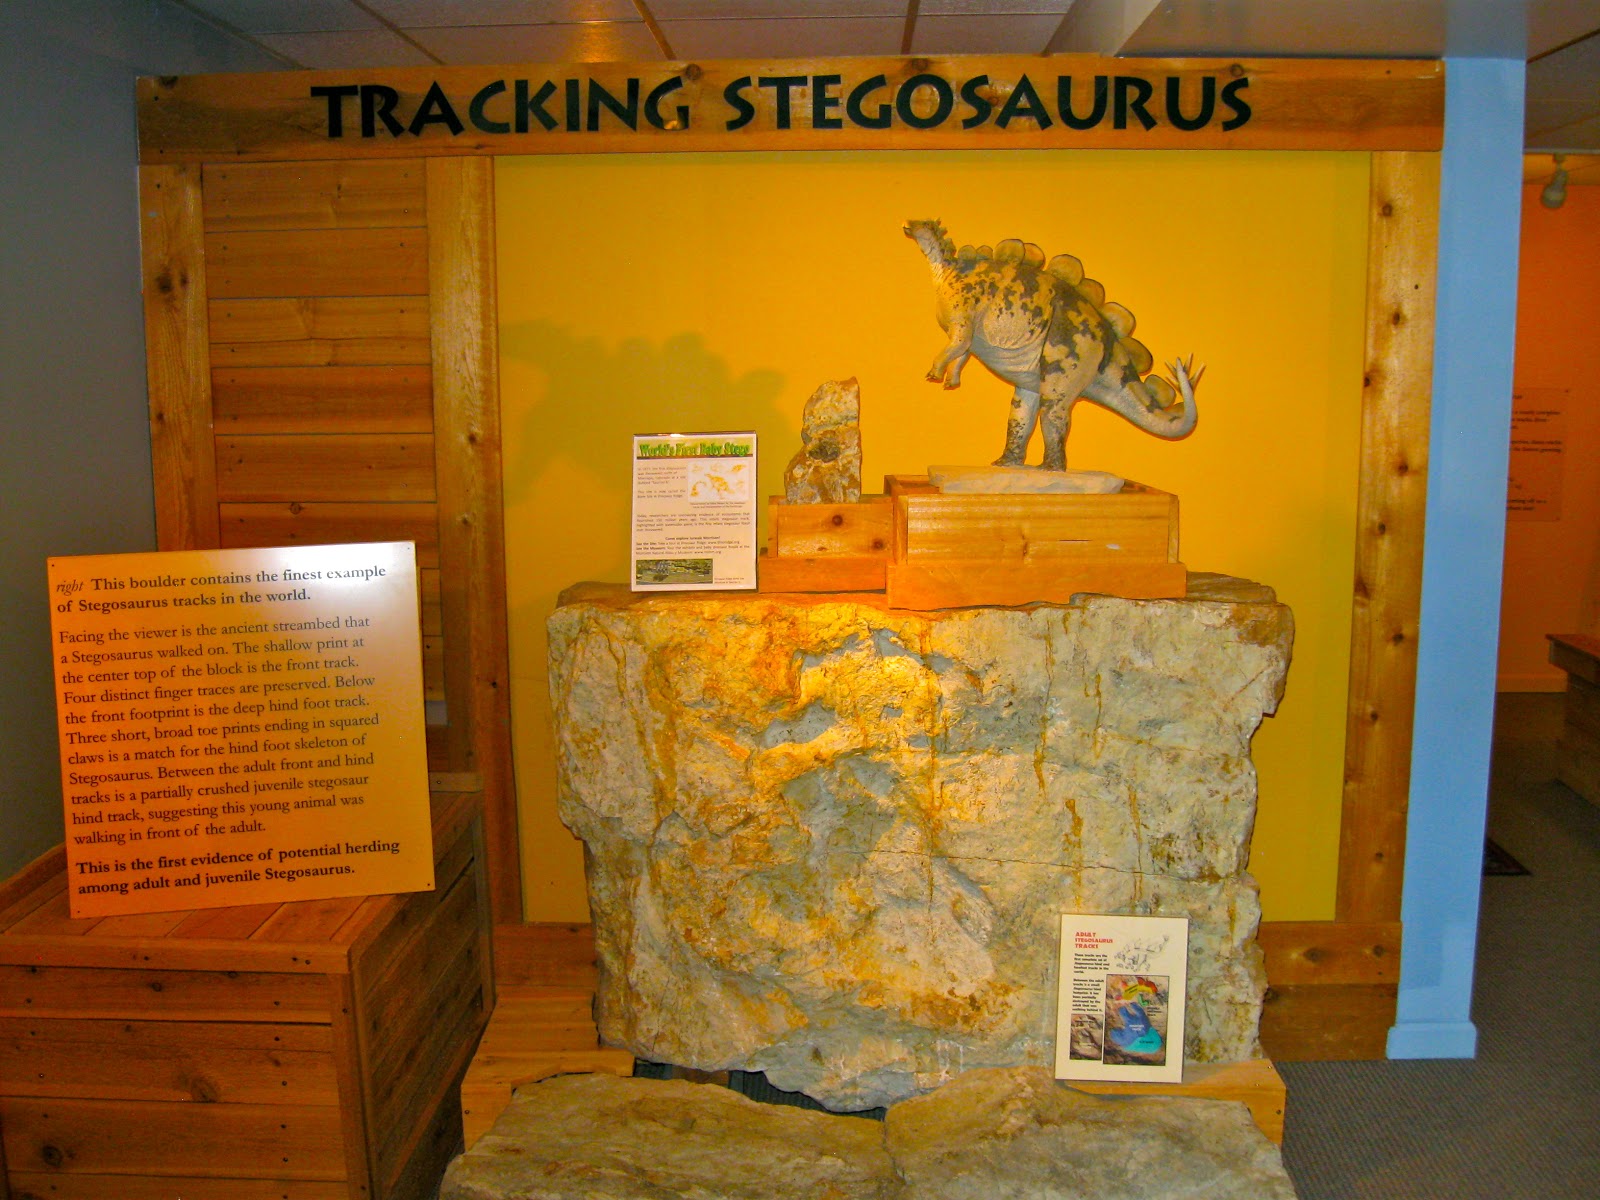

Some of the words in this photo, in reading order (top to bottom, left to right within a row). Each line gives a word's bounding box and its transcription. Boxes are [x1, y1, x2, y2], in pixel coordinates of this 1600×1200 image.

[310, 76, 690, 138] TRACKING
[723, 73, 1253, 132] STEGOSAURUS
[57, 579, 84, 596] right
[91, 578, 125, 590] This
[130, 575, 186, 588] boulder
[191, 575, 251, 585] contains
[256, 571, 278, 582] the
[283, 569, 322, 580] finest
[327, 566, 385, 581] example
[58, 600, 73, 612] of
[79, 599, 168, 614] Stegosaurus
[173, 594, 216, 606] tracks
[221, 592, 234, 604] in
[240, 592, 261, 603] the
[266, 588, 310, 601] world.
[59, 631, 104, 645] Facing
[108, 629, 129, 640] the
[134, 627, 177, 639] viewer
[182, 625, 192, 636] is
[196, 624, 217, 636] the
[221, 622, 269, 634] ancient
[273, 616, 340, 631] streambed
[345, 616, 369, 627] that
[72, 651, 153, 666] Stegosaurus
[157, 644, 203, 658] walked
[208, 647, 228, 655] on.
[232, 642, 259, 654] The
[264, 639, 312, 652] shallow
[317, 639, 348, 653] print
[353, 638, 364, 647] at
[63, 672, 83, 684] the
[88, 672, 129, 682] center
[134, 671, 156, 683] top
[161, 665, 176, 678] of
[182, 665, 202, 676] the
[206, 662, 243, 675] block
[247, 661, 257, 673] is
[262, 660, 282, 672] the
[287, 659, 320, 670] front
[324, 656, 358, 668] track.
[64, 692, 96, 704] Four
[101, 689, 150, 702] distinct
[154, 686, 193, 701] finger
[197, 686, 235, 696] traces
[240, 685, 259, 693] are
[263, 677, 330, 695] preserved.
[335, 675, 375, 687] Below
[65, 712, 86, 724] the
[91, 710, 125, 722] front
[130, 706, 190, 723] footprint
[194, 704, 204, 716] is
[209, 704, 229, 715] the
[233, 701, 265, 716] deep
[269, 698, 298, 711] hind
[303, 697, 330, 709] foot
[334, 694, 369, 707] track.
[66, 732, 106, 744] Three
[111, 729, 150, 742] short,
[154, 725, 193, 739] broad
[198, 727, 218, 736] toe
[222, 724, 260, 738] prints
[265, 719, 309, 733] ending
[313, 717, 325, 728] in
[330, 713, 379, 731] squared
[68, 752, 104, 764] claws
[109, 751, 118, 762] is
[123, 753, 130, 761] a
[134, 746, 175, 760] match
[180, 745, 200, 757] for
[204, 744, 224, 755] the
[229, 740, 258, 754] hind
[263, 740, 290, 751] foot
[295, 736, 348, 749] skeleton
[352, 733, 367, 745] of
[70, 772, 153, 787] Stegosaurus.
[157, 767, 214, 778] Between
[219, 762, 239, 774] the
[243, 760, 276, 773] adult
[281, 758, 313, 770] front
[317, 755, 341, 768] and
[345, 752, 374, 766] hind
[71, 791, 110, 804] tracks
[115, 790, 125, 801] is
[141, 785, 193, 804] partially
[198, 781, 249, 796] crushed
[254, 777, 304, 795] juvenile
[308, 777, 368, 791] stegosaur
[72, 811, 103, 824] hind
[108, 808, 144, 822] track,
[149, 807, 218, 822] suggesting
[222, 802, 245, 814] this
[250, 802, 290, 816] young
[294, 795, 336, 809] animal
[340, 796, 364, 805] was
[74, 831, 126, 846] walking
[130, 829, 142, 840] in
[147, 827, 180, 839] front
[184, 824, 199, 836] of
[205, 823, 225, 835] the
[230, 820, 265, 833] adult.
[76, 861, 110, 874] This
[115, 859, 126, 871] is
[131, 858, 153, 870] the
[158, 856, 186, 868] first
[191, 852, 253, 865] evidence
[258, 848, 273, 860] of
[279, 843, 341, 863] potential
[345, 840, 400, 854] herding
[78, 883, 129, 895] among
[133, 876, 170, 890] adult
[175, 874, 201, 887] and
[206, 870, 260, 887] juvenile
[265, 866, 354, 882] Stegosaurus.
